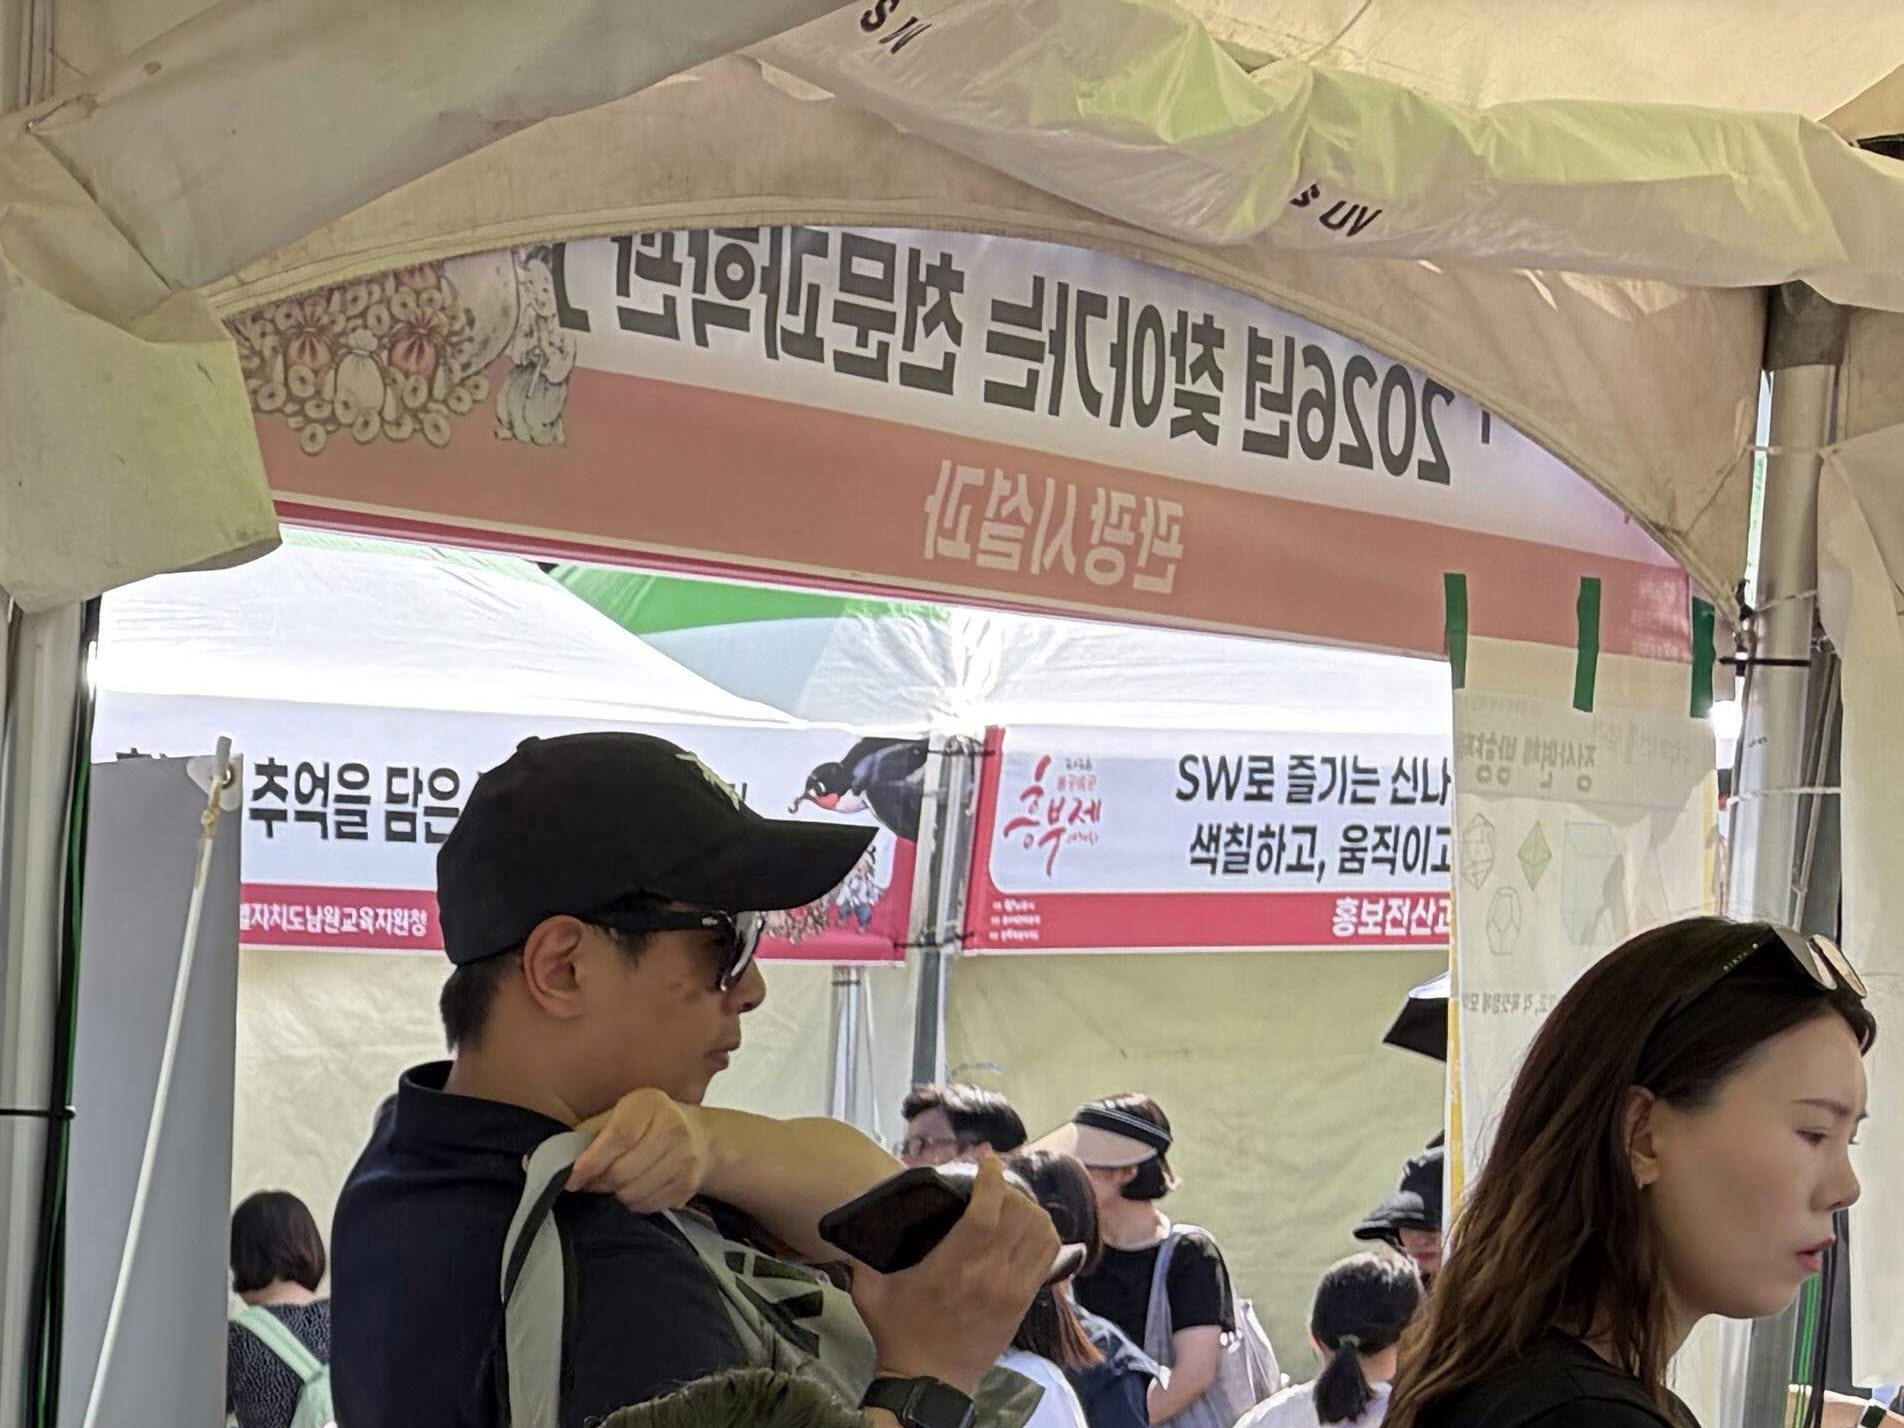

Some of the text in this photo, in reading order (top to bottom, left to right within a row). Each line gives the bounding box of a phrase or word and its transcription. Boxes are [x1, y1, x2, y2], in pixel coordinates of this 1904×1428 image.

[249, 755, 460, 844] 추억을 담은
[1002, 754, 1102, 877] 흥부제
[1174, 754, 1276, 804] SW로
[1286, 756, 1381, 804] 즐기는
[1188, 824, 1327, 883] 색칠하고,
